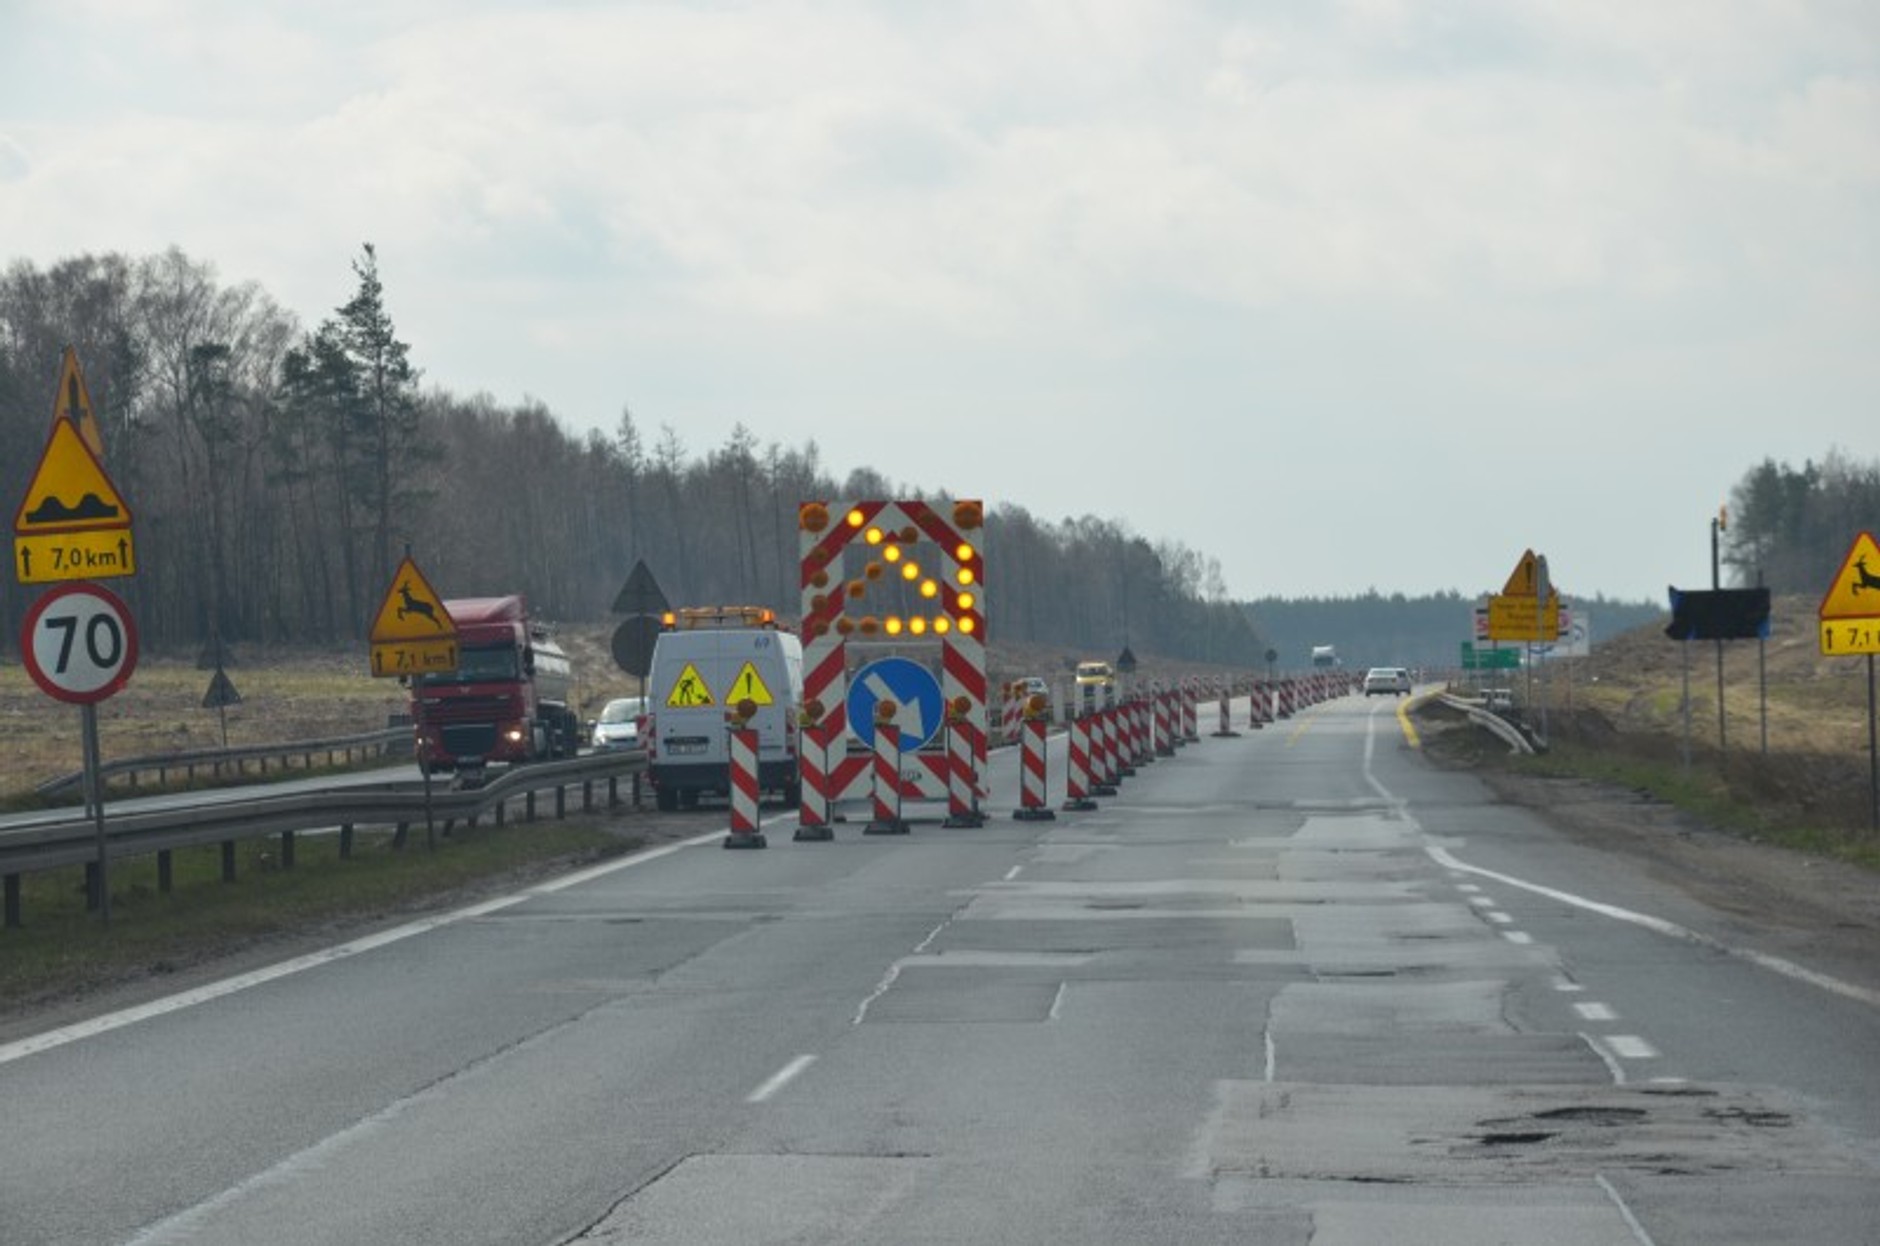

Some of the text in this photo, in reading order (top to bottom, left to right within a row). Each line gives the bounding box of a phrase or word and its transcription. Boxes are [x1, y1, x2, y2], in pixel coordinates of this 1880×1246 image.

[51, 547, 116, 573] 7,0 km
[45, 613, 121, 674] 70
[423, 650, 446, 666] km
